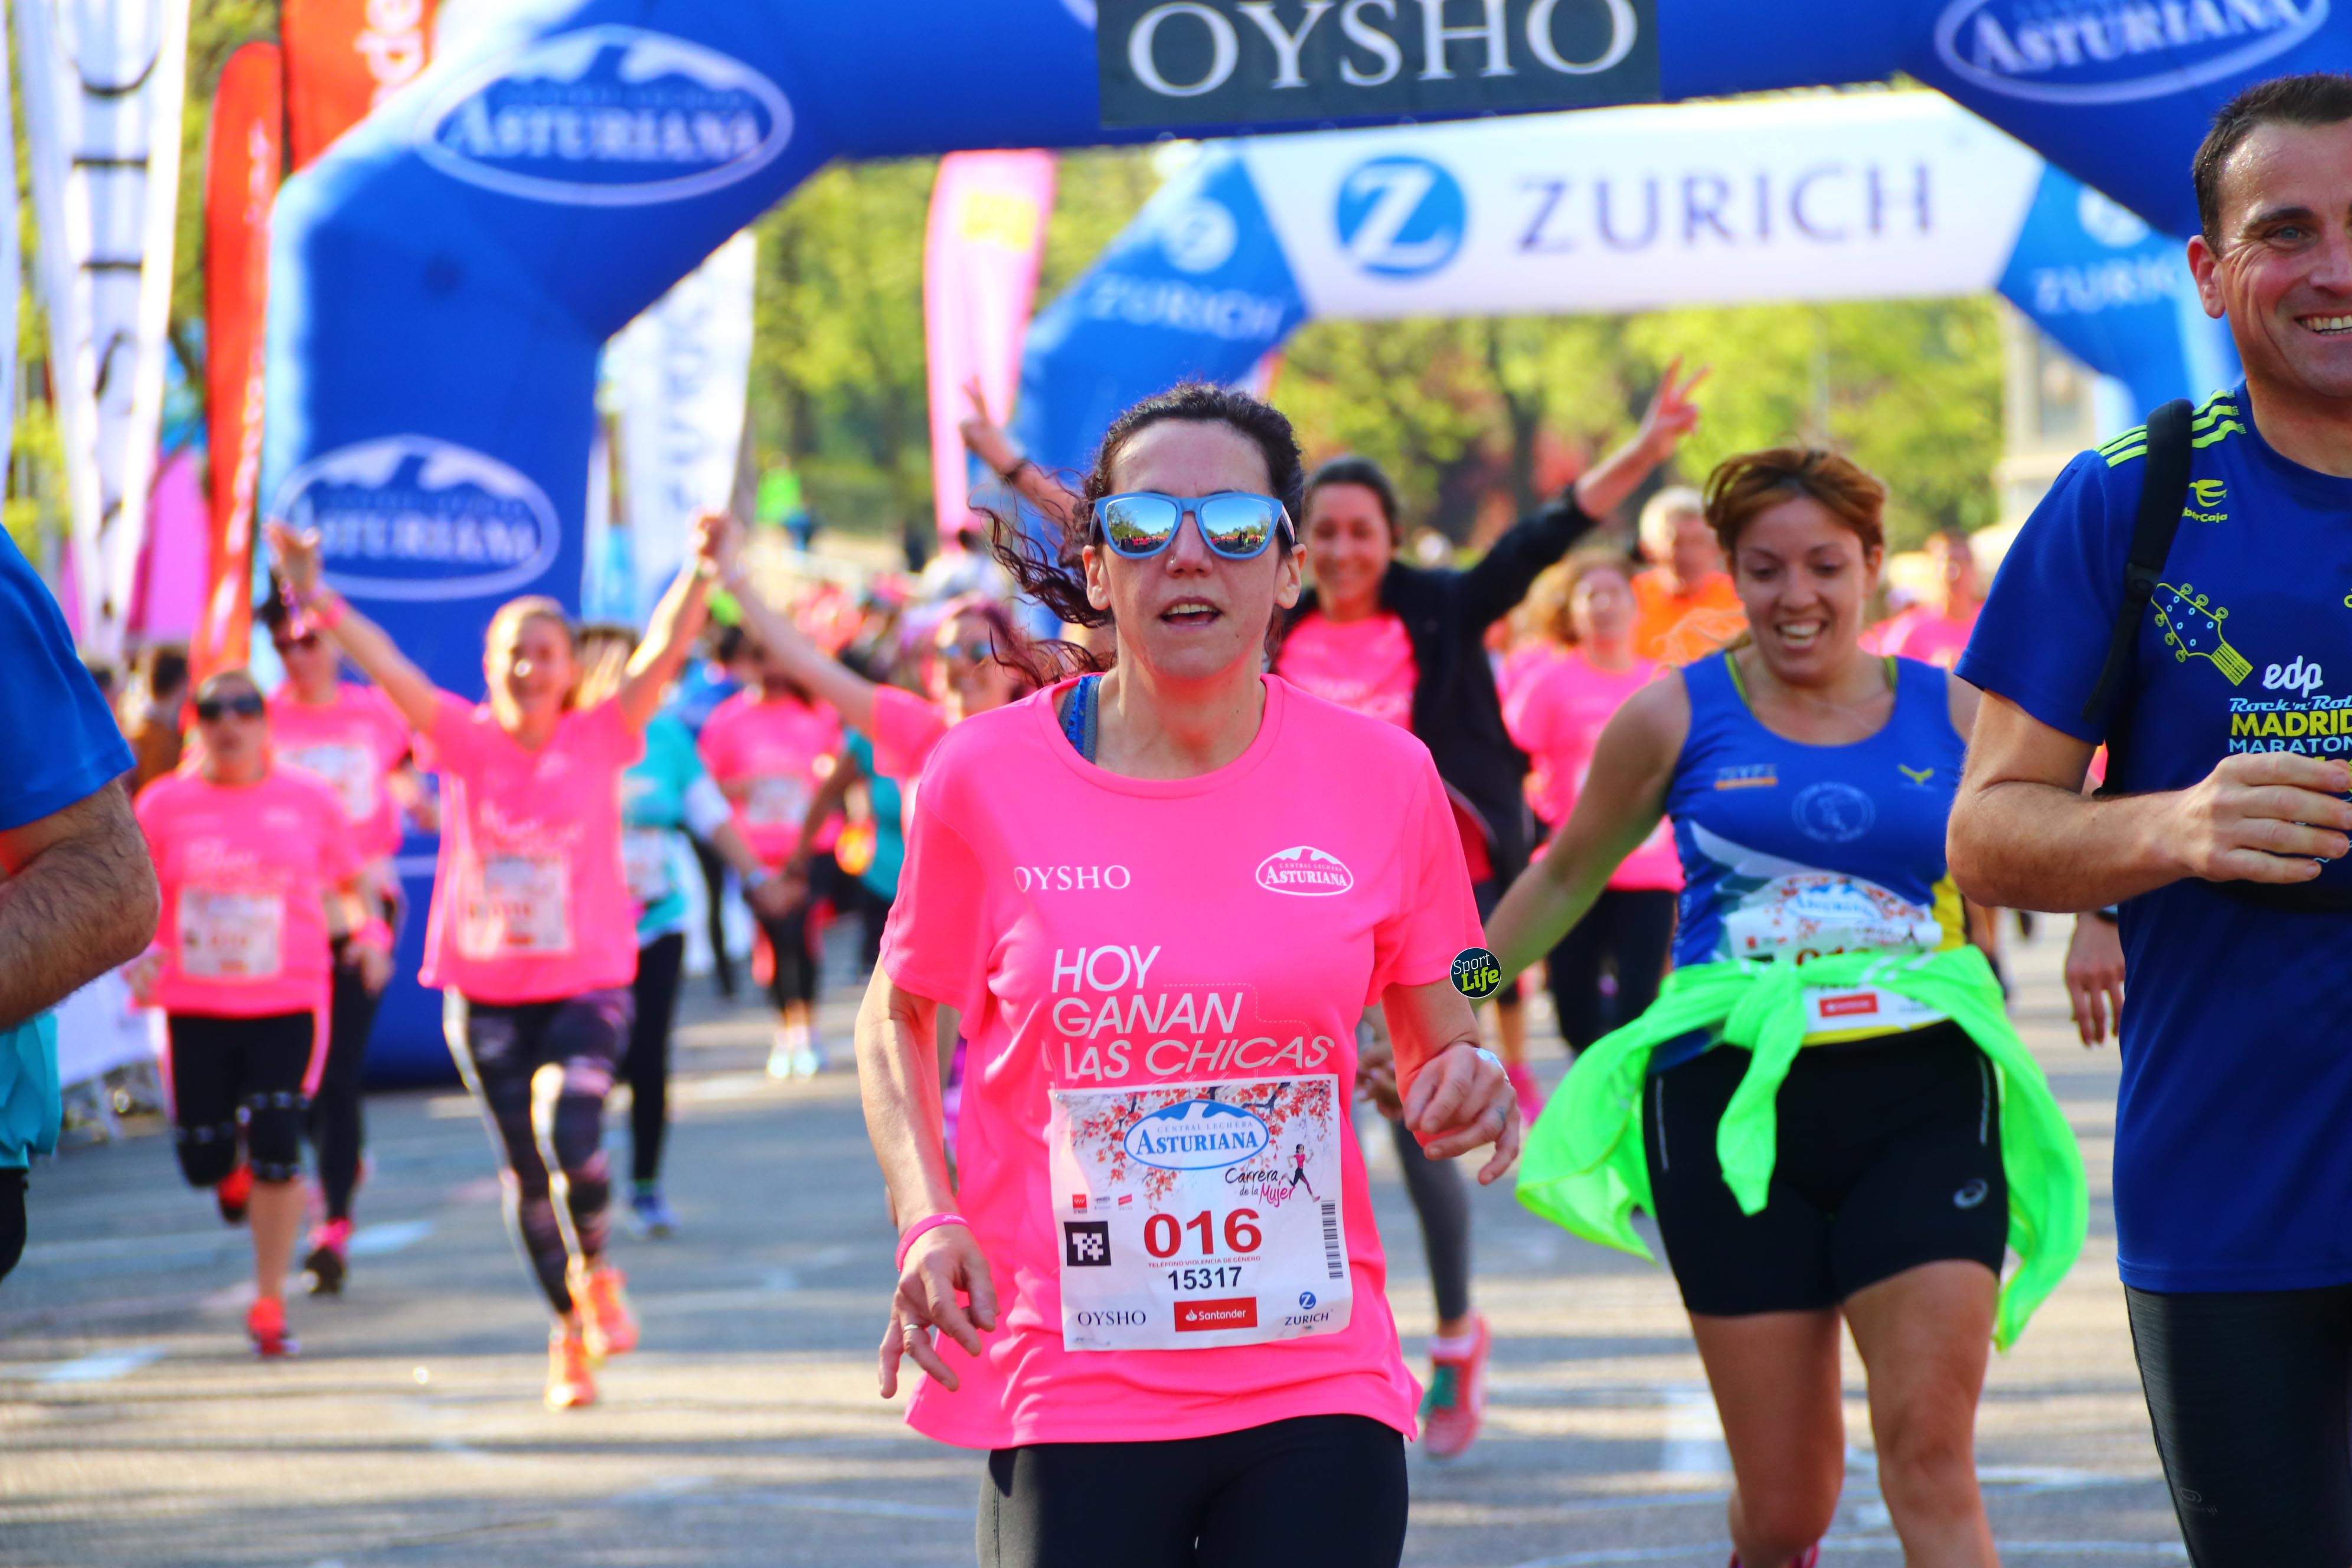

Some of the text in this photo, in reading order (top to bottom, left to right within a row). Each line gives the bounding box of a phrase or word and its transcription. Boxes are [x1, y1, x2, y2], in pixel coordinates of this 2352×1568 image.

[1127, 0, 1638, 97] OYSHO
[1516, 159, 1933, 254] ZURICH
[2262, 655, 2323, 698] edp
[1265, 865, 1348, 887] ASTURIANA
[1051, 946, 1161, 993] HOY
[1053, 992, 1243, 1039] GANAN
[1064, 1035, 1335, 1082] LAS CHICAS
[1157, 1122, 1253, 1133] CENTRAL LECHERA
[1136, 1129, 1259, 1155] ASTURIANA
[1225, 1168, 1278, 1184] Carrera
[1240, 1180, 1296, 1208] de la Mujer
[1144, 1208, 1262, 1259] 016
[1185, 1258, 1221, 1266] VIOLENCIA
[1168, 1266, 1242, 1291] 15317
[1077, 1309, 1146, 1327] OYSHO
[1199, 1308, 1246, 1321] Santander
[1285, 1312, 1329, 1326] ZURICH
